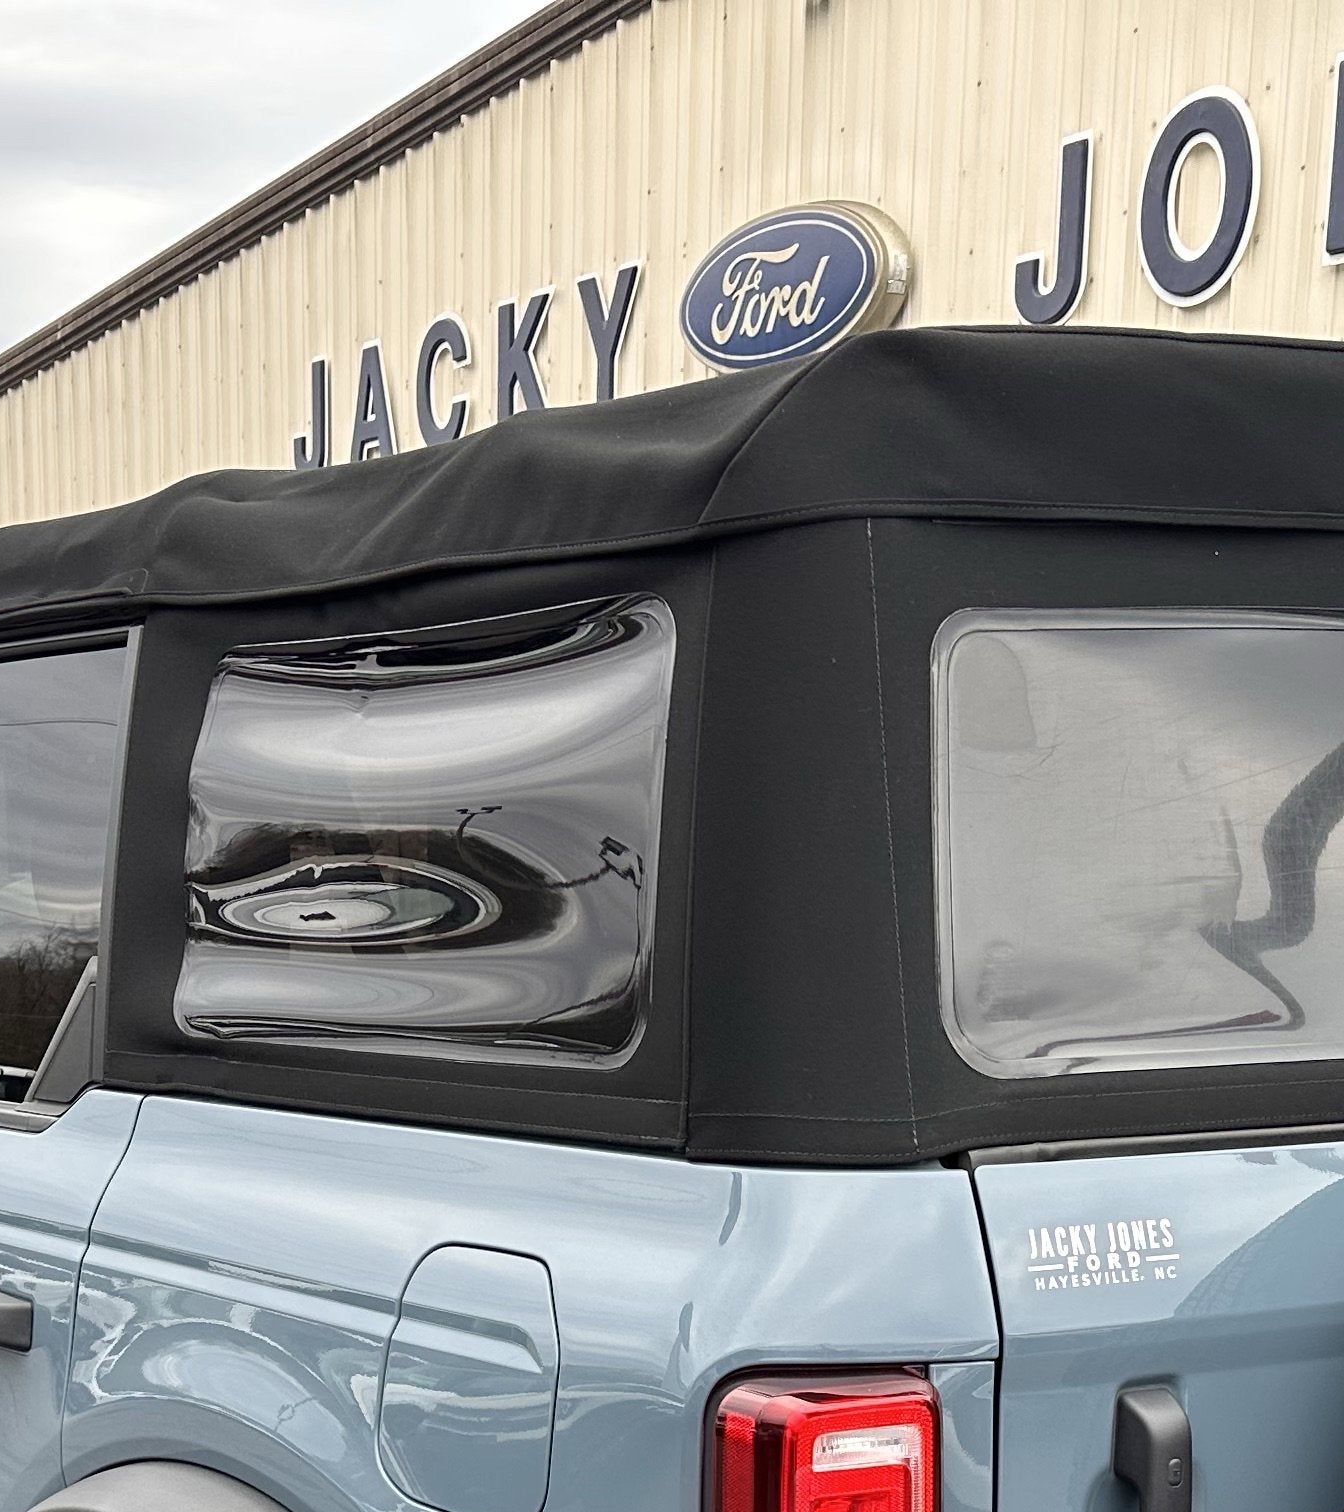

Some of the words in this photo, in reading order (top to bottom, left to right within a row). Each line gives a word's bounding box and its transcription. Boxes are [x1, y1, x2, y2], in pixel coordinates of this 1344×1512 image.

[711, 242, 829, 347] Ford
[293, 259, 644, 470] JACKY
[1028, 1223, 1097, 1260] JACKY
[1107, 1217, 1174, 1253] JONES
[1067, 1251, 1141, 1273] FORD
[1154, 1265, 1177, 1280] NC
